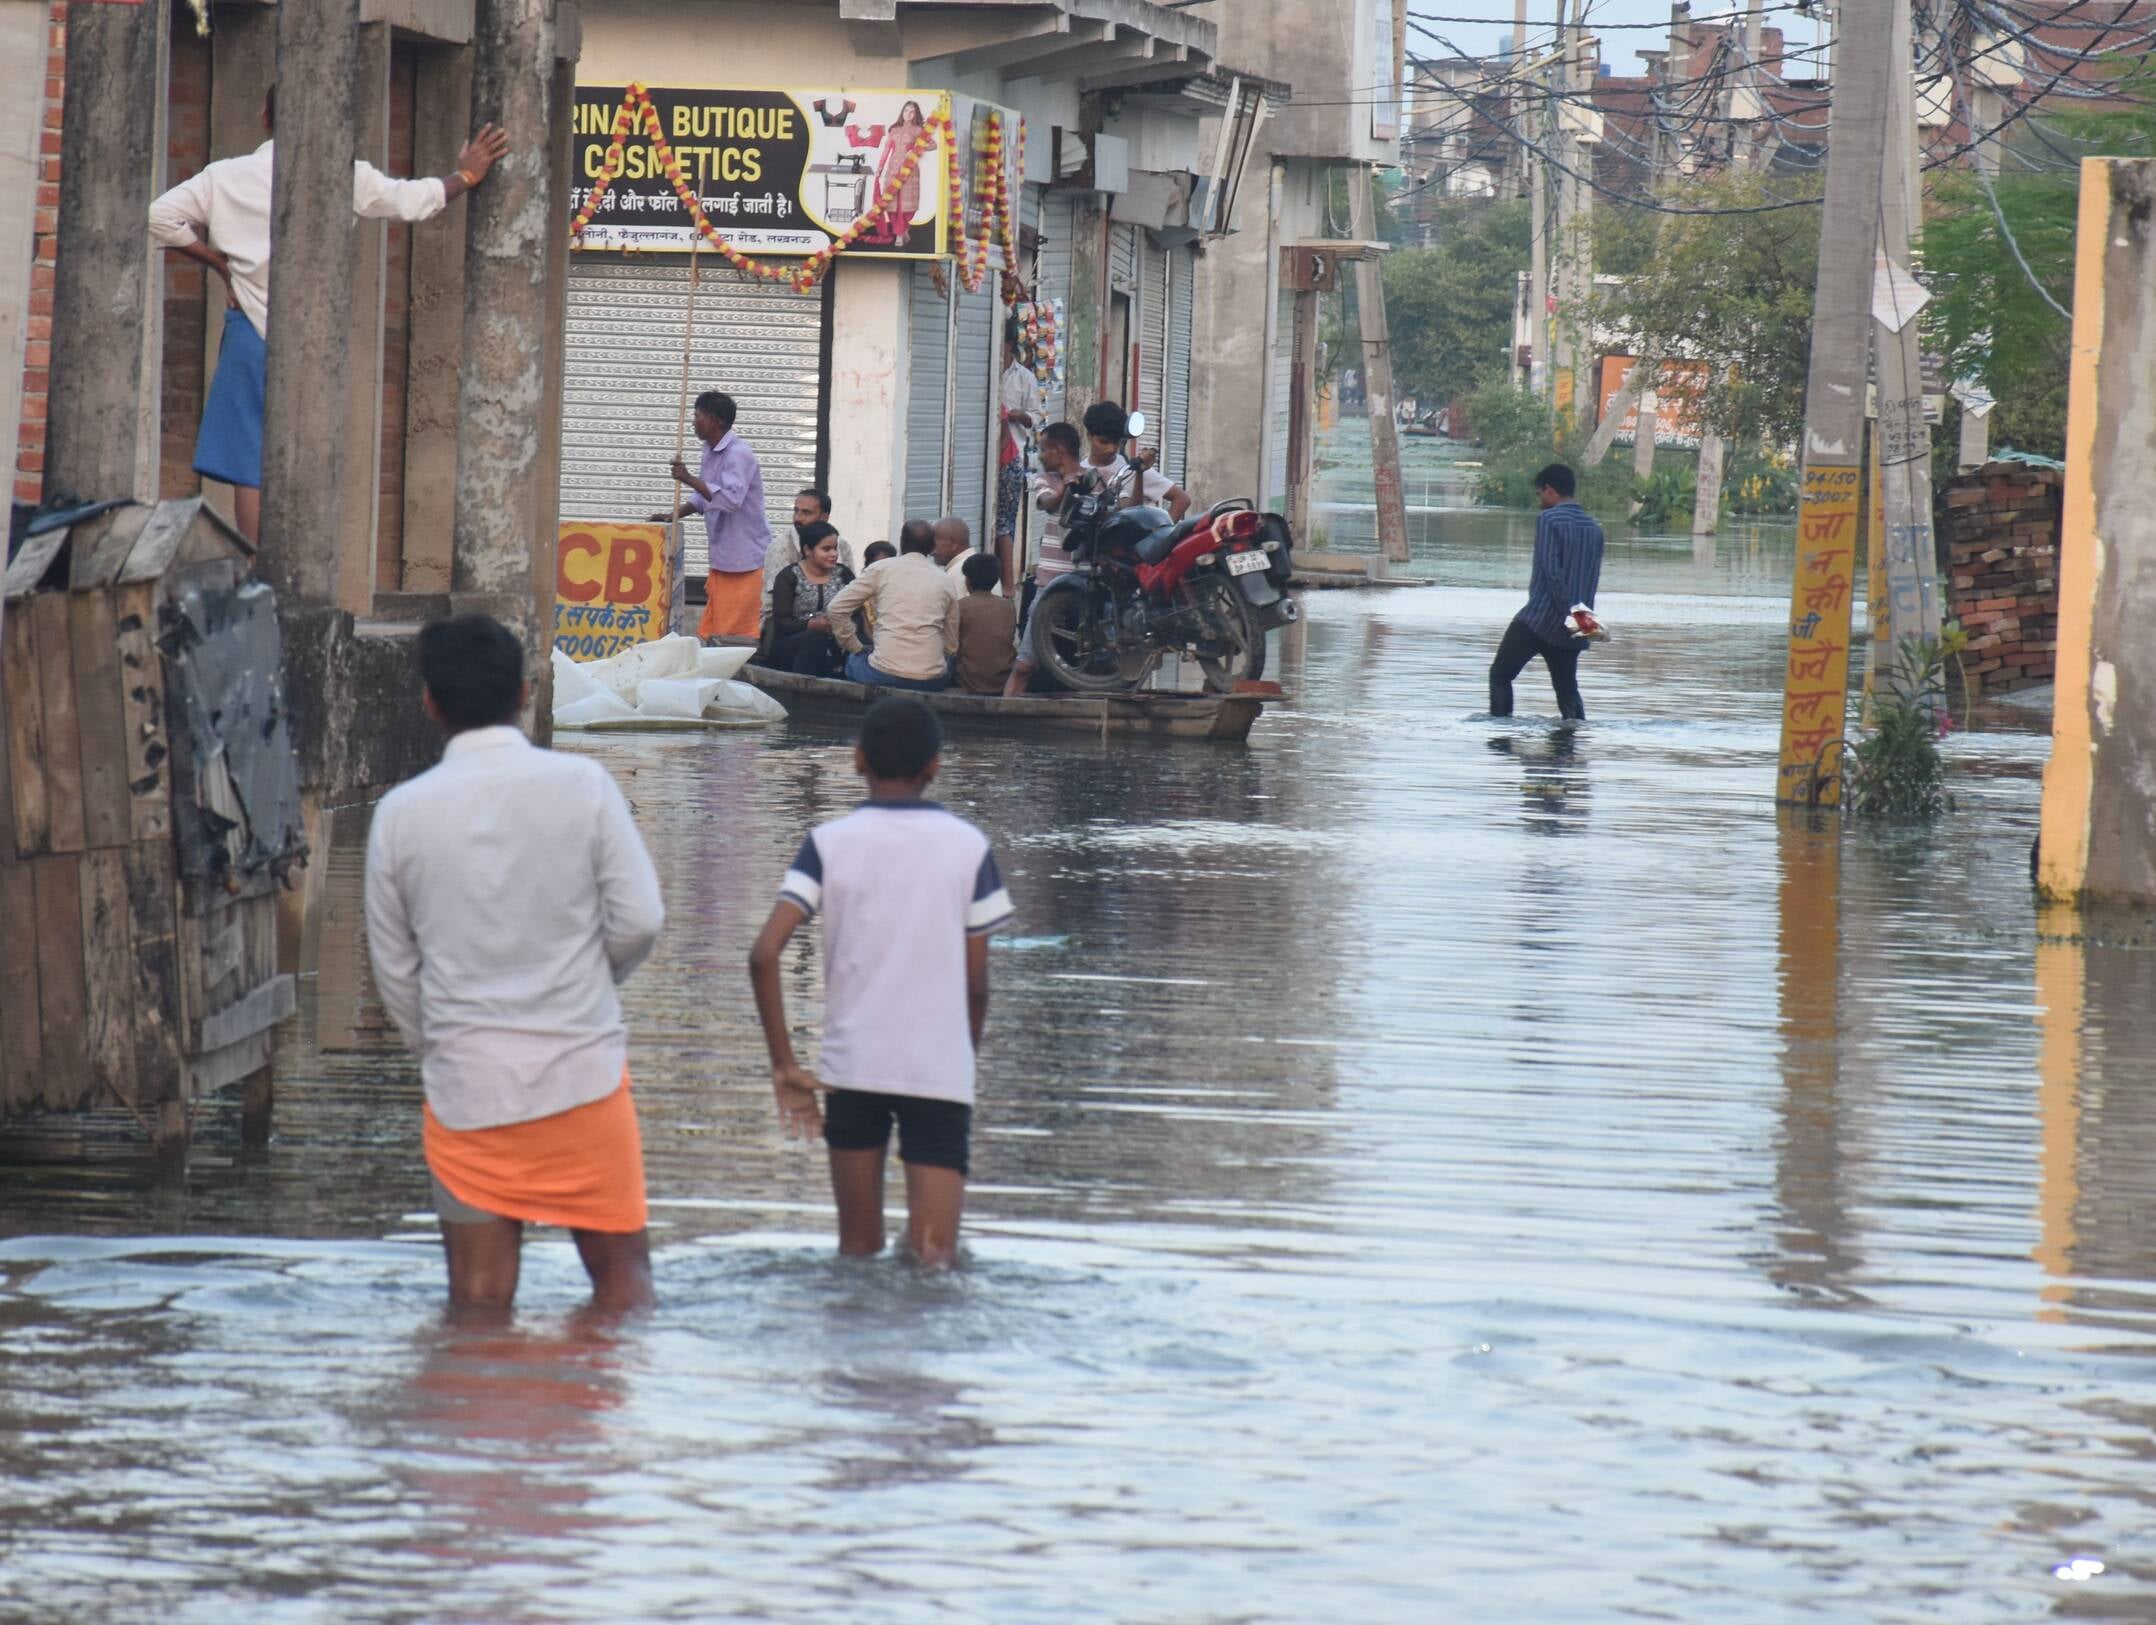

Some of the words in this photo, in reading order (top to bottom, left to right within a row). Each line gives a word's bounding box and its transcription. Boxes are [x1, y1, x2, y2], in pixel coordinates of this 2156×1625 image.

[673, 105, 795, 140] BUTIQUE
[584, 143, 762, 182] COSMETICS
[620, 188, 645, 212] और
[702, 191, 740, 216] लगाई
[743, 192, 773, 214] जाती
[1805, 471, 1857, 486] 94150
